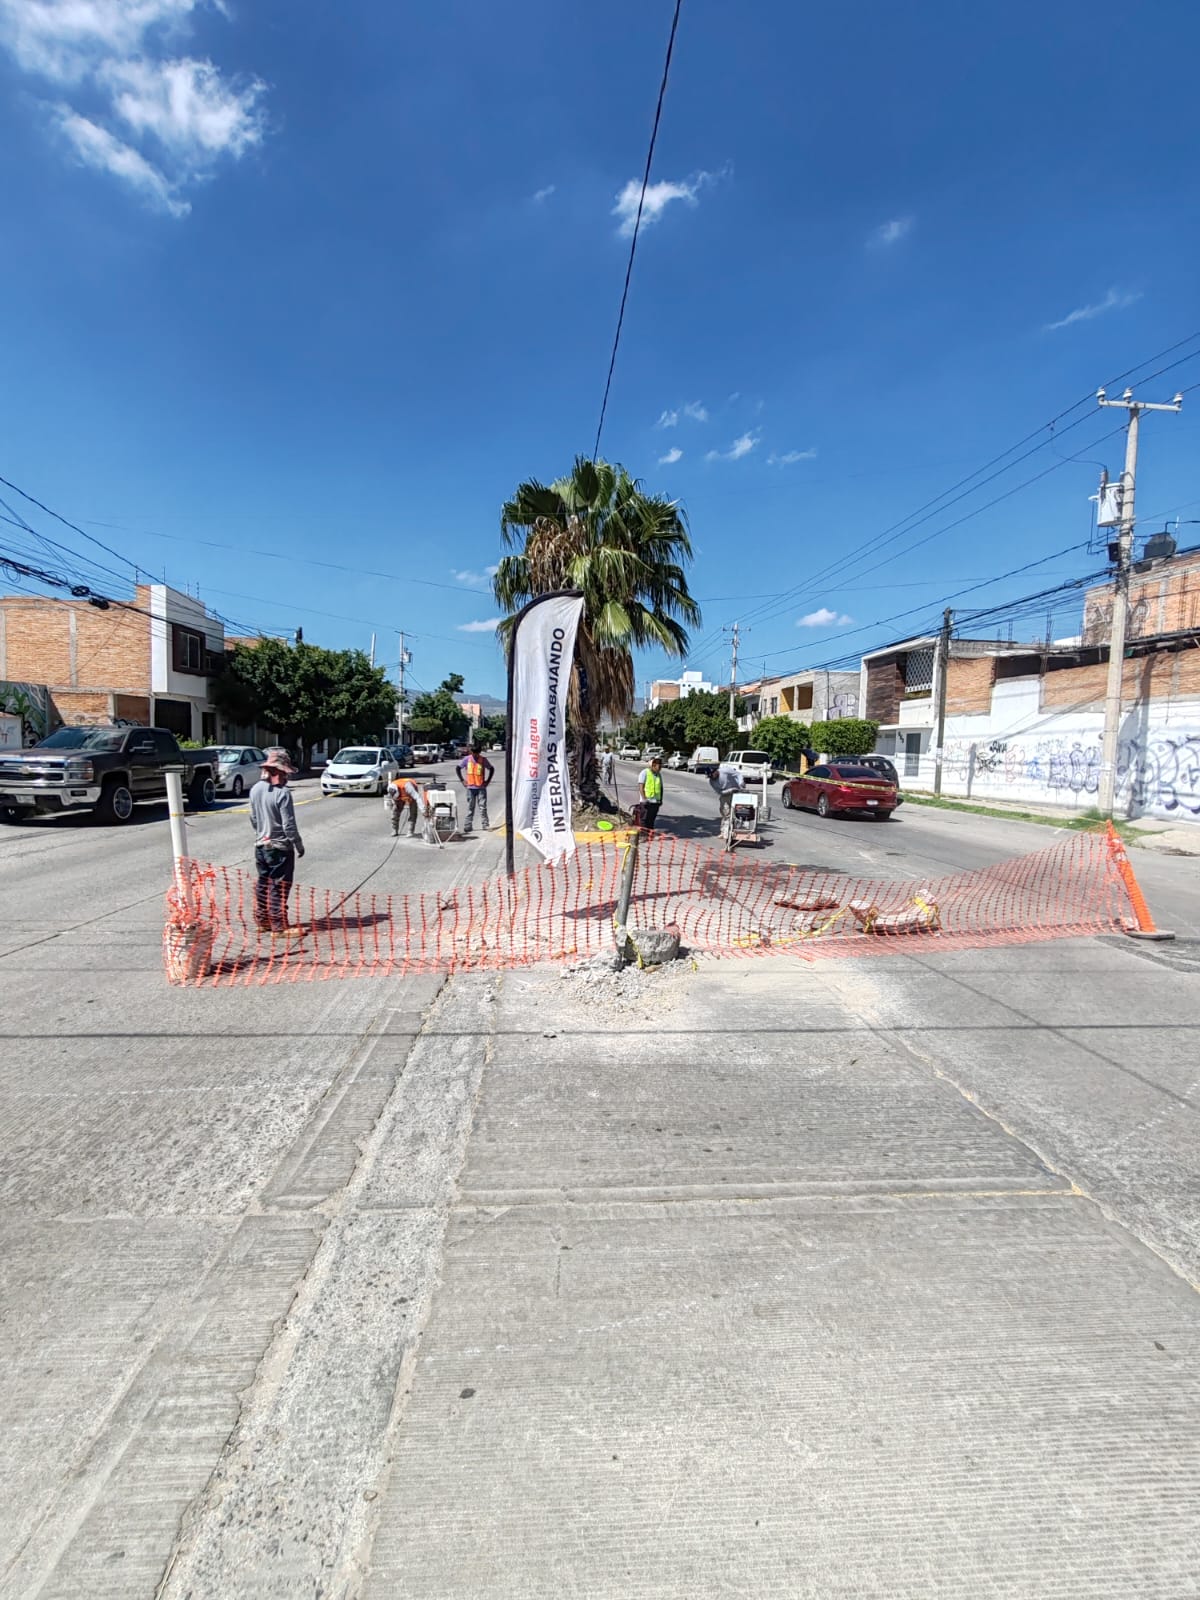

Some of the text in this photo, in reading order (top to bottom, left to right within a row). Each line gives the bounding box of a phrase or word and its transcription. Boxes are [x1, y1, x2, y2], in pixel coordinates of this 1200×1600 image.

[528, 718, 540, 750] agua
[547, 628, 566, 833] INTERAPAS TRABAJANDO
[528, 752, 540, 764] al
[529, 782, 541, 830] interapas
